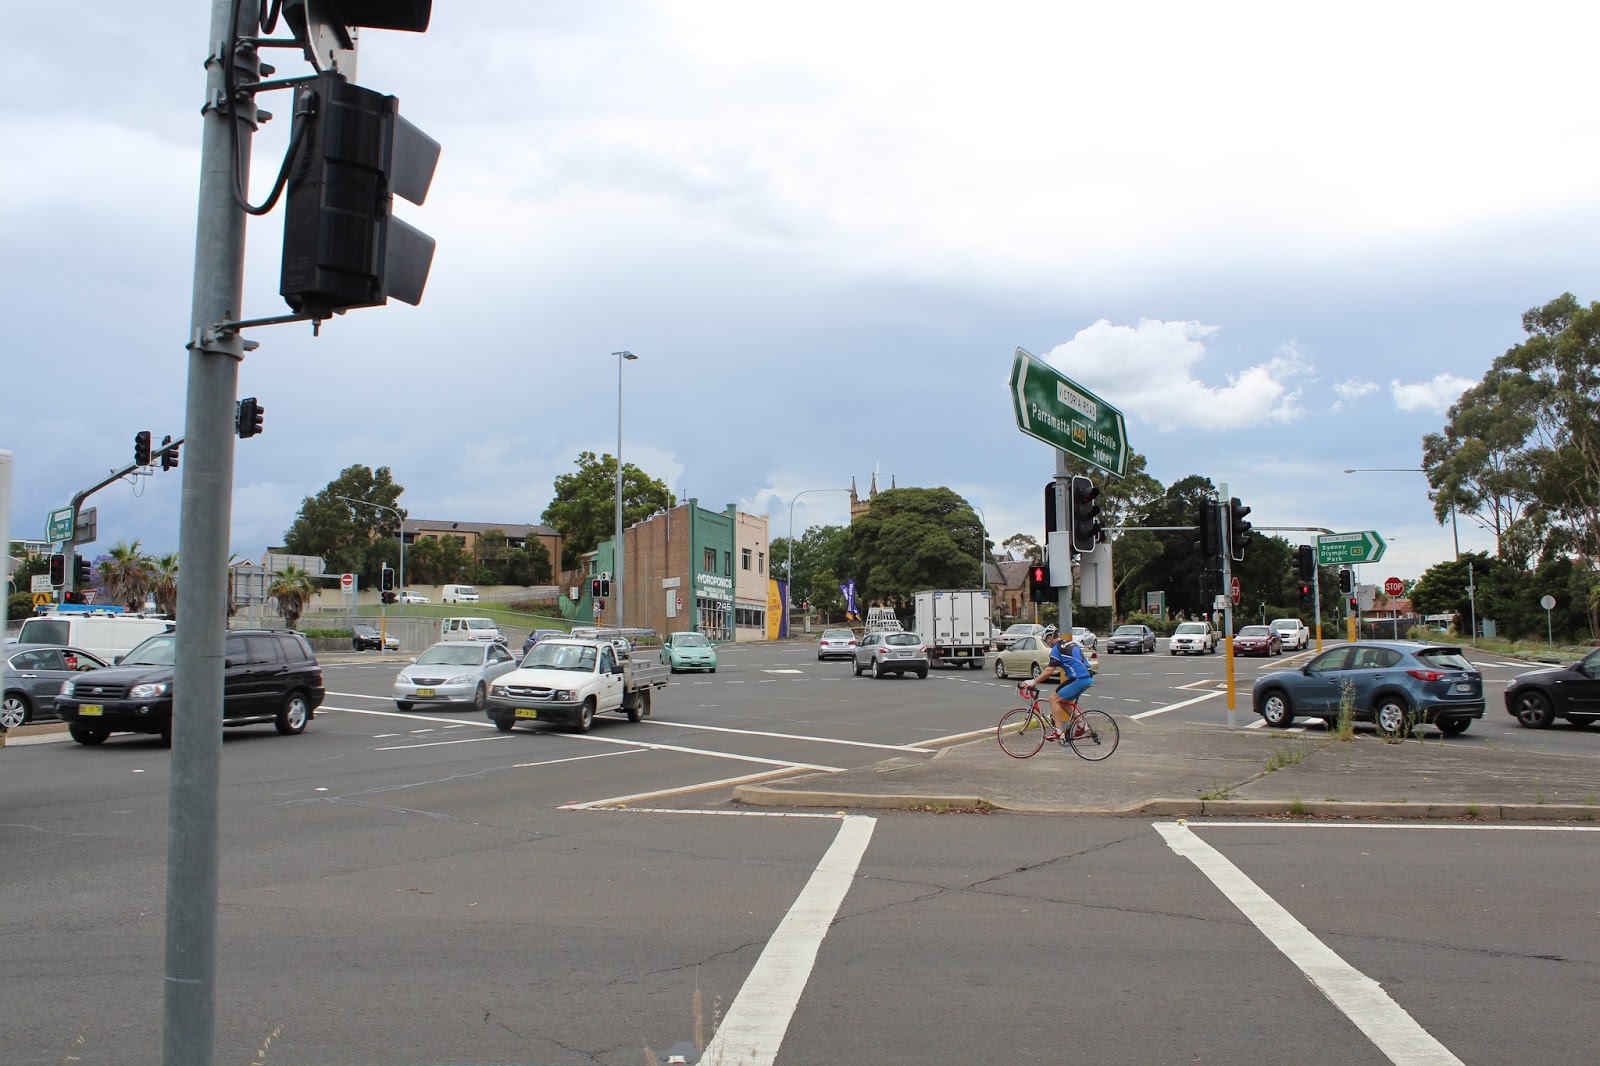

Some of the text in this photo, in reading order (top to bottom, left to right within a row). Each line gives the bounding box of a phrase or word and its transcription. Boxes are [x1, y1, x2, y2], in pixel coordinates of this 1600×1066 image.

[1059, 387, 1096, 417] VICTORIA ROAD
[1032, 403, 1070, 435] Parramatta
[1087, 424, 1116, 451] Gladesville
[1092, 444, 1112, 468] Sydney
[697, 573, 732, 588] HYDROPONICS
[1385, 582, 1402, 591] STOP
